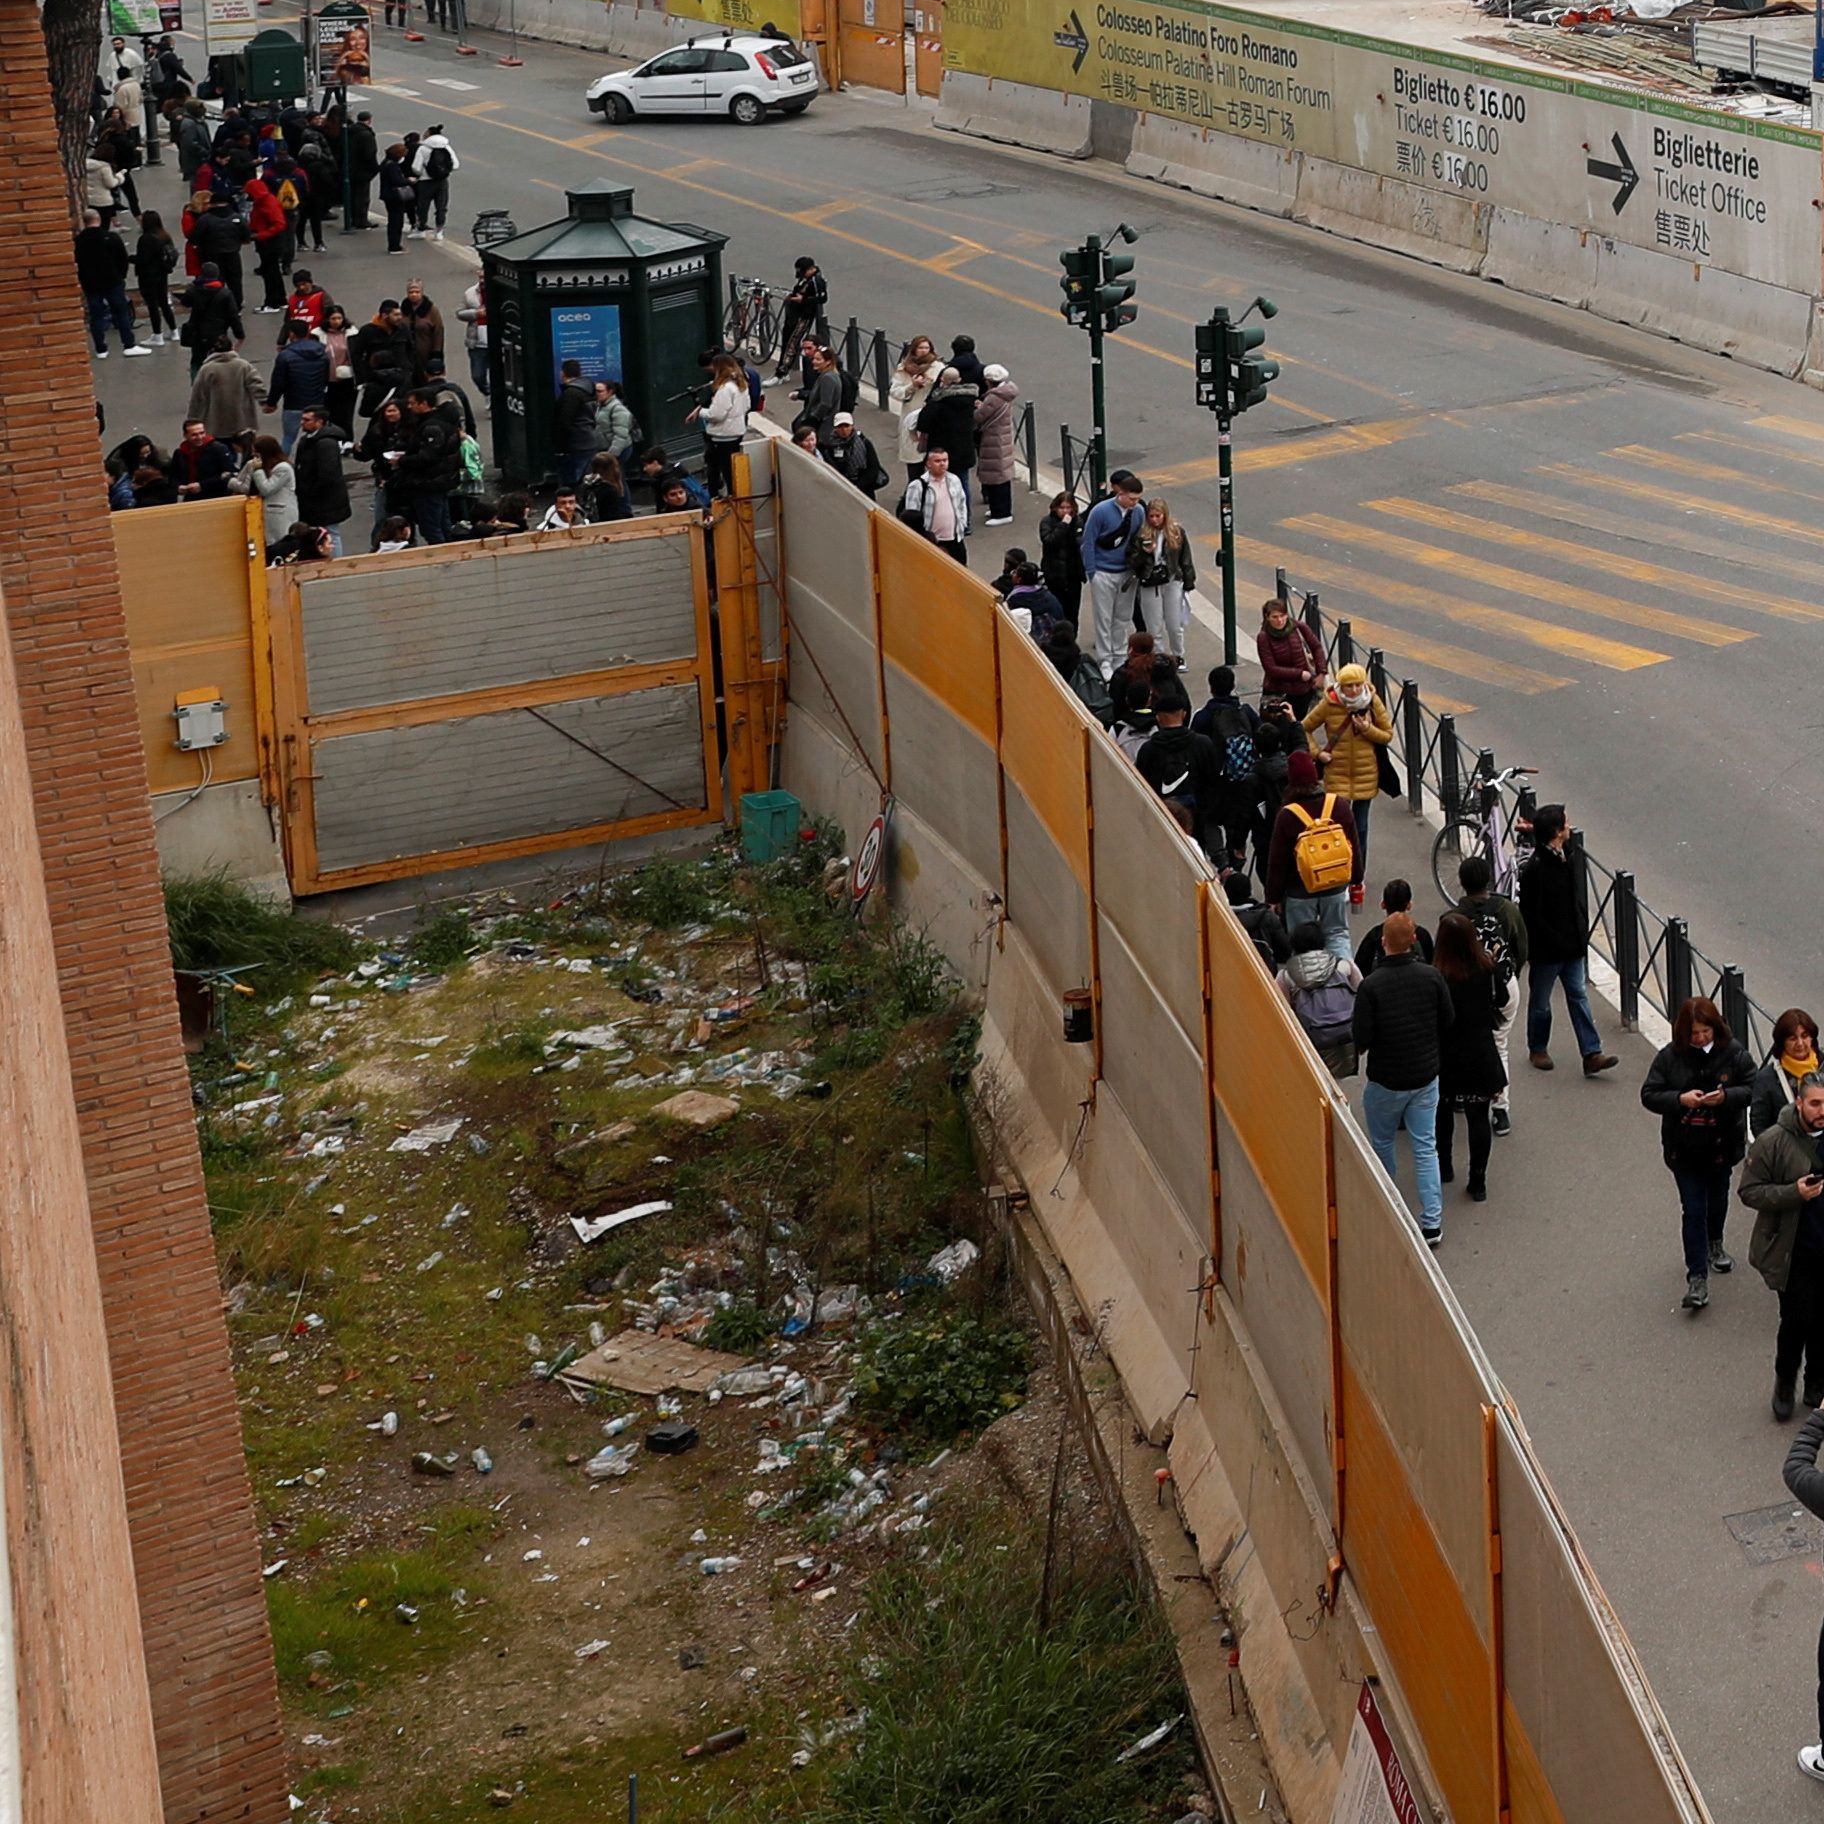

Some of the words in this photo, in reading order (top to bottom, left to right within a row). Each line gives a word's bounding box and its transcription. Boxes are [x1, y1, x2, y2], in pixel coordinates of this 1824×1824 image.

[1097, 4, 1152, 38] Colosseo
[1155, 15, 1208, 49] Palatino
[1211, 26, 1239, 57] Foro
[1242, 35, 1297, 69] Romano
[1098, 37, 1164, 70] Colosseum
[1166, 53, 1214, 83] Palatine
[1216, 63, 1236, 86] Hill
[1238, 72, 1284, 99] Roman
[1287, 84, 1331, 111] Forum
[1394, 67, 1460, 107] Biglietto
[1464, 84, 1475, 111] €
[1479, 89, 1526, 123] 16.00
[1394, 103, 1438, 141] Ticket
[1442, 116, 1454, 144] €
[1457, 119, 1499, 155] 16.00
[1654, 127, 1759, 179] Biglietterie
[1396, 141, 1426, 177] 票价
[1432, 153, 1443, 179] €
[1447, 156, 1488, 191] 1600
[1654, 167, 1706, 209] Ticket
[1712, 183, 1766, 223] Office
[1655, 209, 1710, 256] 售票处
[558, 312, 591, 322] acea
